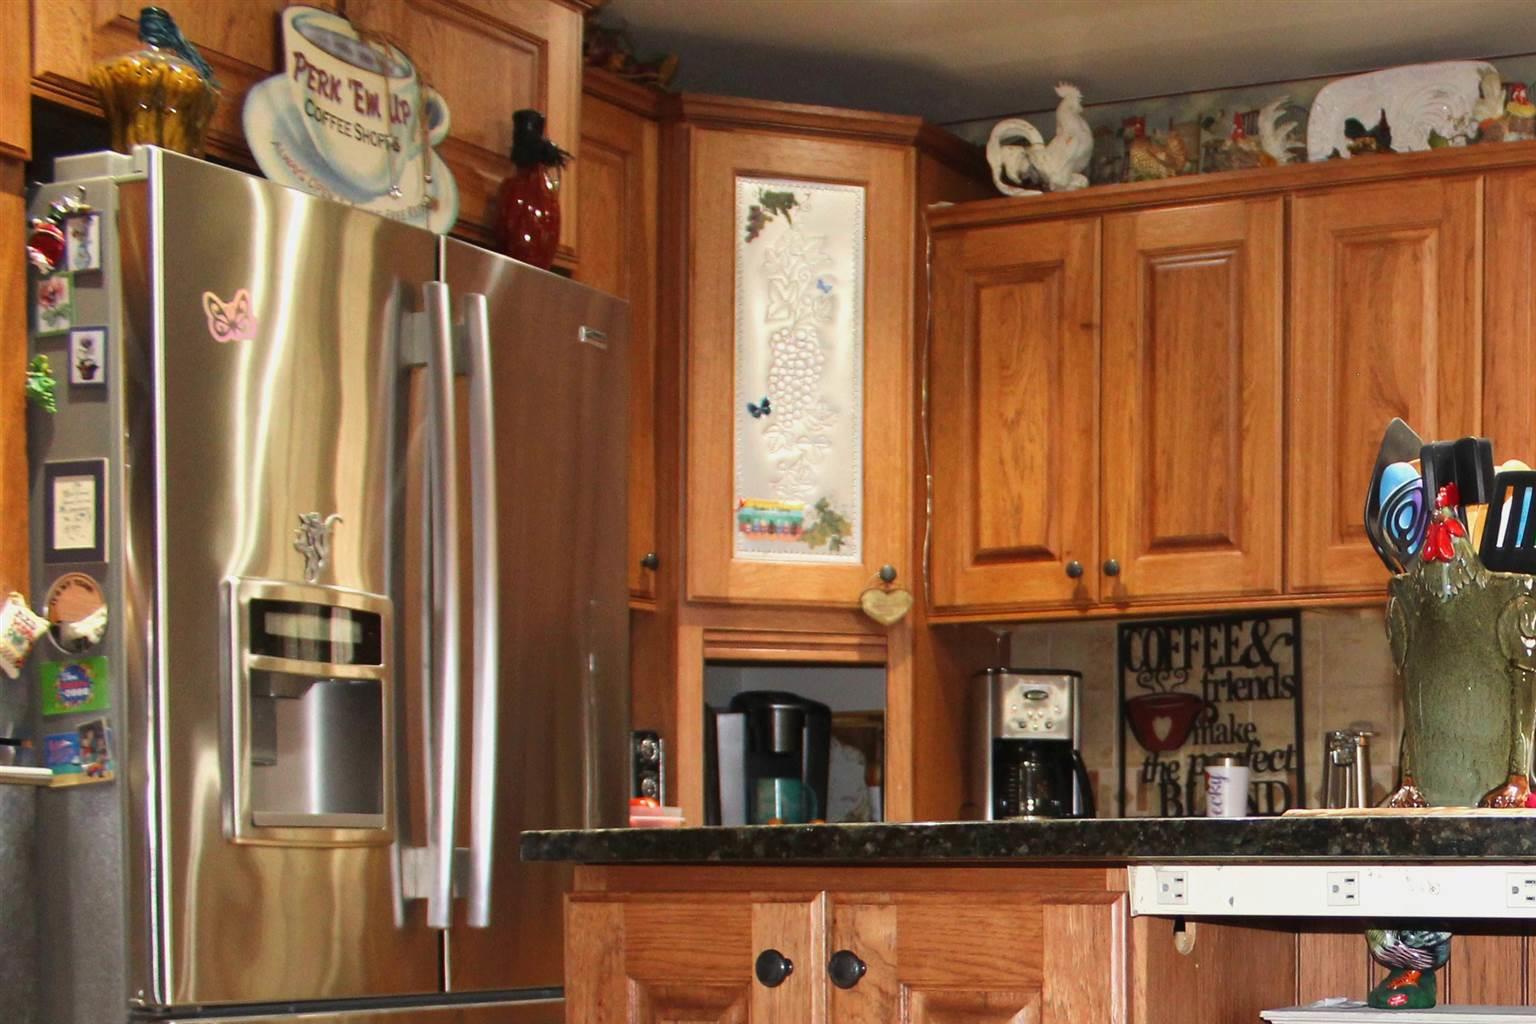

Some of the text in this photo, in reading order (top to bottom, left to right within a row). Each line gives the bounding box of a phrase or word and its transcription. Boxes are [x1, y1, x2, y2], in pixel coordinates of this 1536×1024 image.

[293, 51, 341, 103] PERK
[389, 93, 410, 125] UP
[304, 98, 353, 138] COFFEE
[1201, 663, 1297, 703] friends
[1193, 713, 1259, 746] make
[1141, 752, 1181, 785] the
